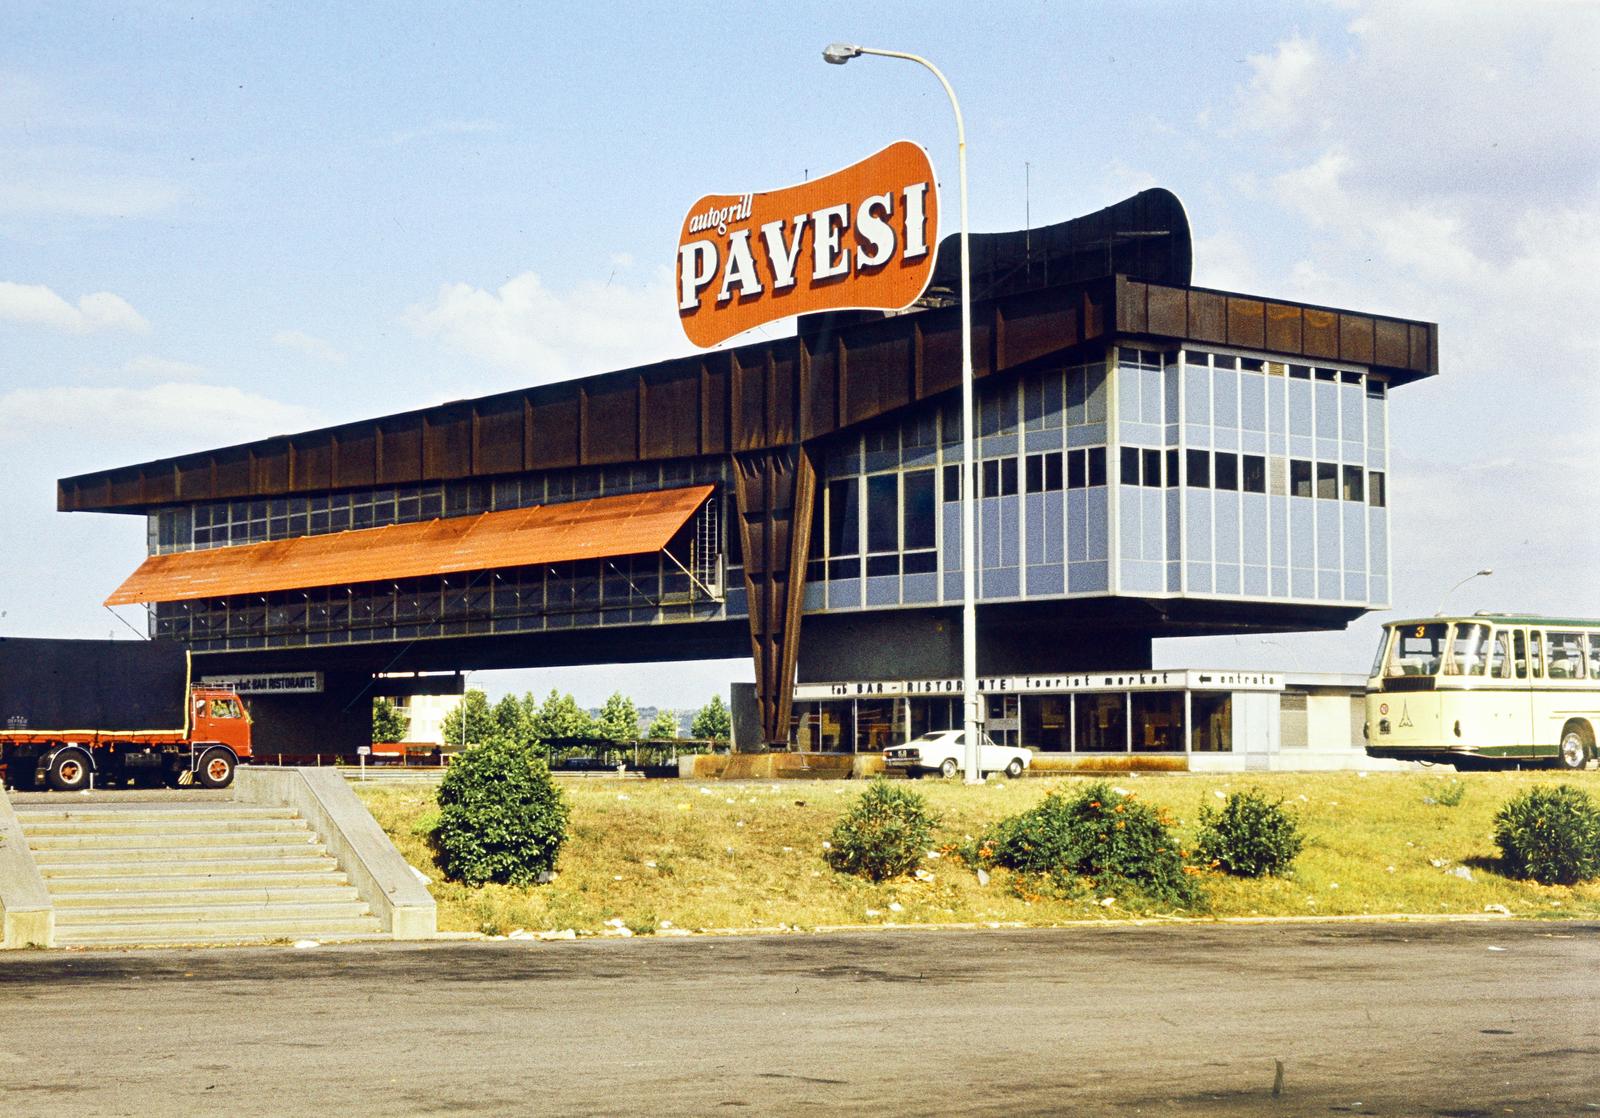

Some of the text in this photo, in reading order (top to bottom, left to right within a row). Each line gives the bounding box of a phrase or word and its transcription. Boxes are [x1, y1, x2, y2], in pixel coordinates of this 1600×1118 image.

[689, 193, 753, 235] autogrill
[679, 181, 929, 313] PAVESI
[1415, 626, 1425, 638] 3
[857, 683, 883, 694] BAR
[907, 679, 1006, 693] RISTORNTE
[1026, 674, 1089, 688] tourist
[1104, 672, 1168, 686] market
[1220, 672, 1274, 685] entrata
